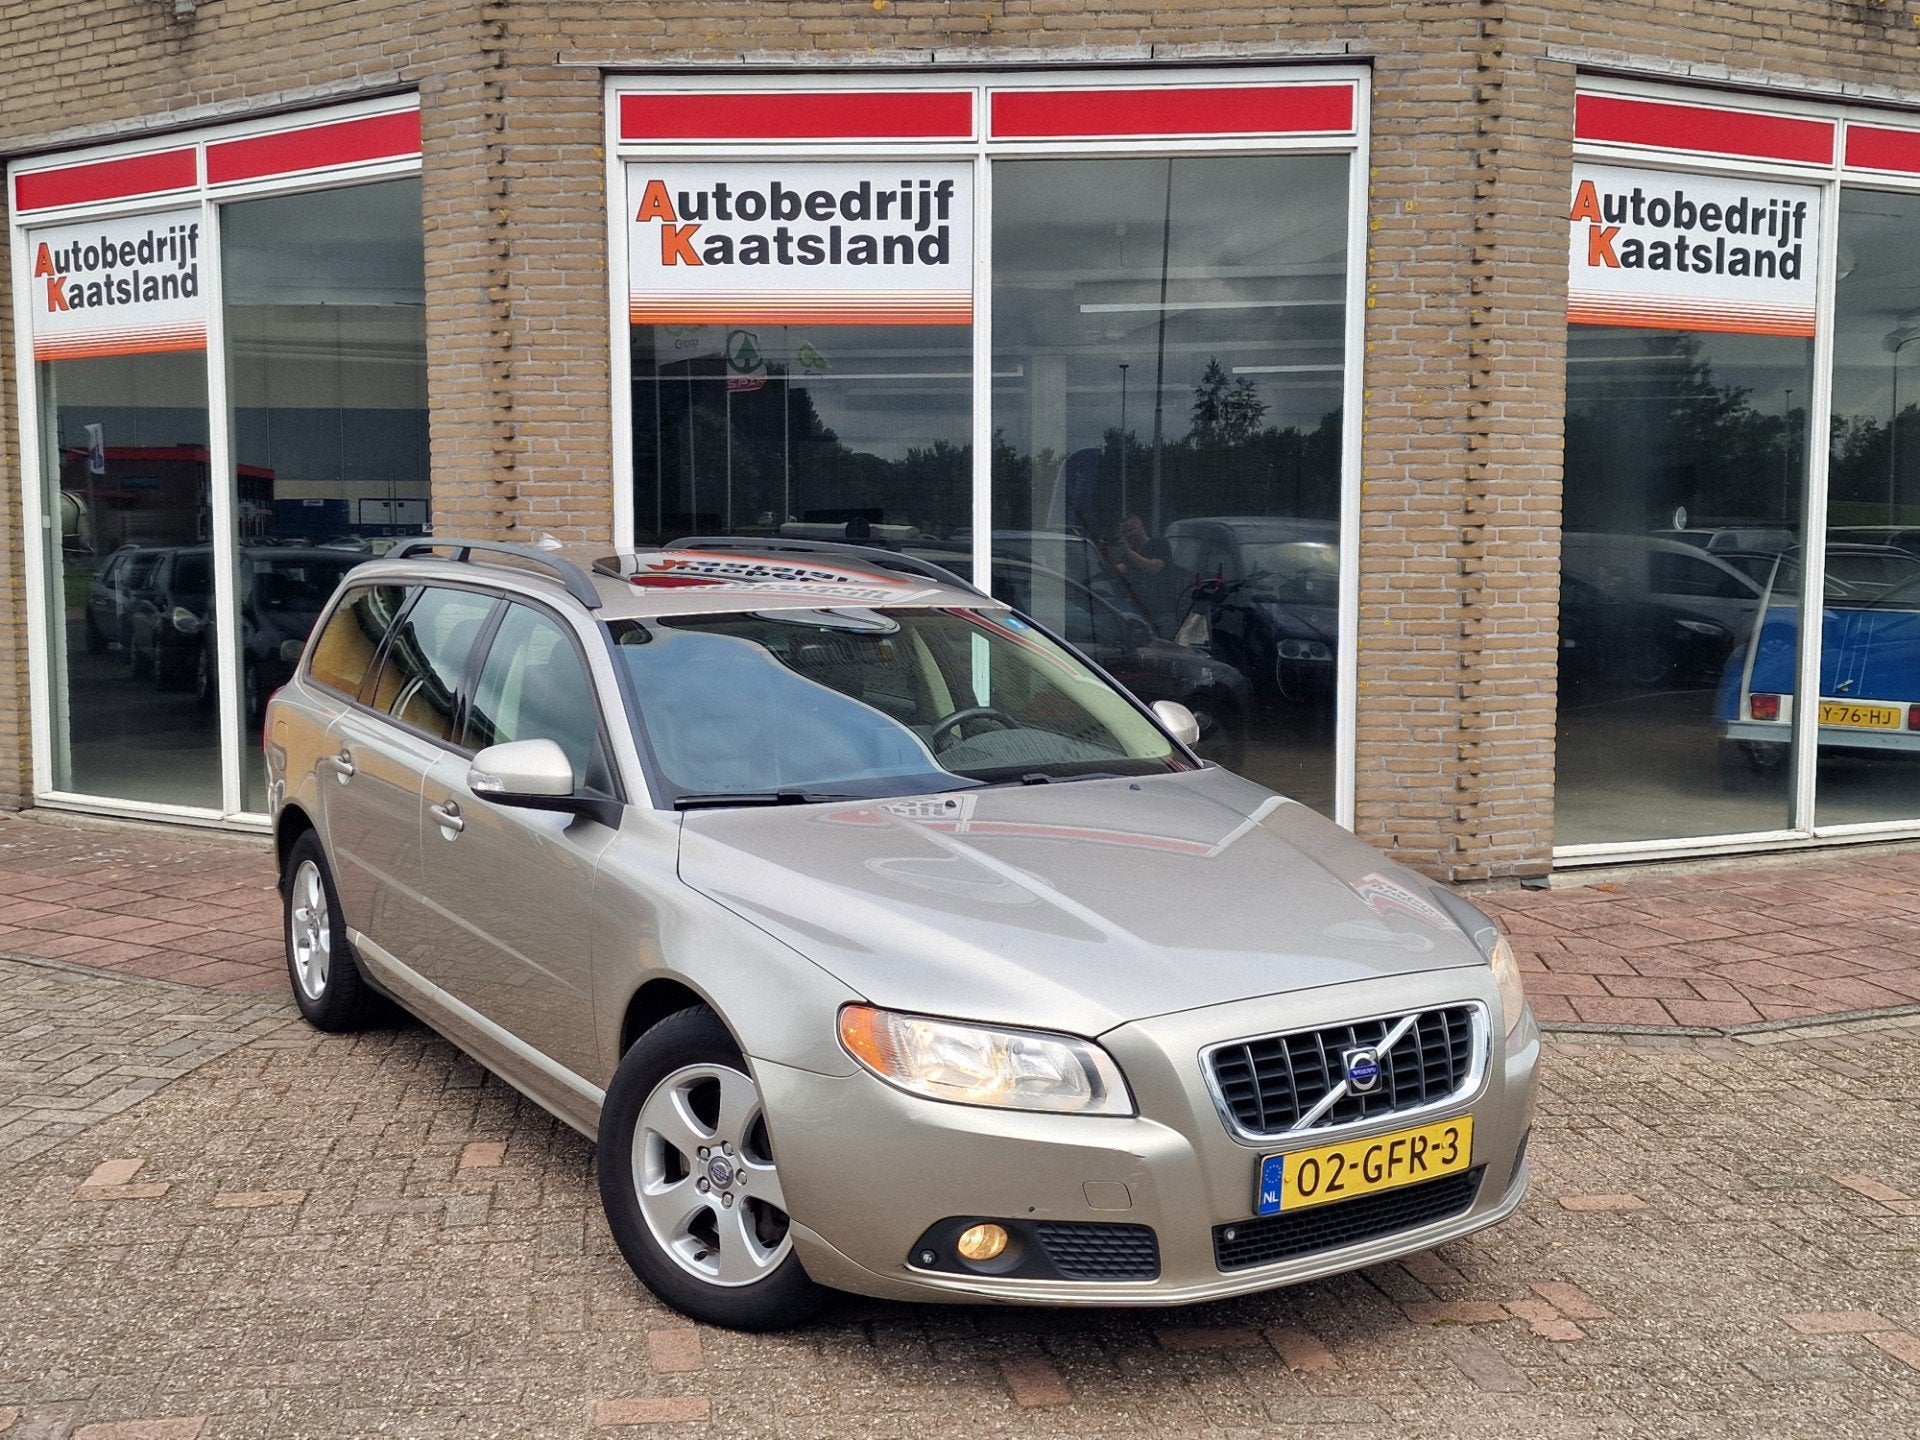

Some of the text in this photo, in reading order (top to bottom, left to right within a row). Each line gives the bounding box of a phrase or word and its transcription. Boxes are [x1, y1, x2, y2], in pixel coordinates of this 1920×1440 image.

[635, 180, 954, 231] Autobedrijf
[1570, 180, 1807, 248] Autobedrijf
[34, 223, 199, 278] Autobedrijf
[661, 224, 950, 266] Kaatsland
[1588, 225, 1802, 281] Kaatsland
[47, 263, 198, 312] Kaatsland
[1820, 706, 1892, 725] Y-76-HJ
[1297, 1127, 1459, 1197] 02-GFR-3
[1263, 1190, 1279, 1204] NL
